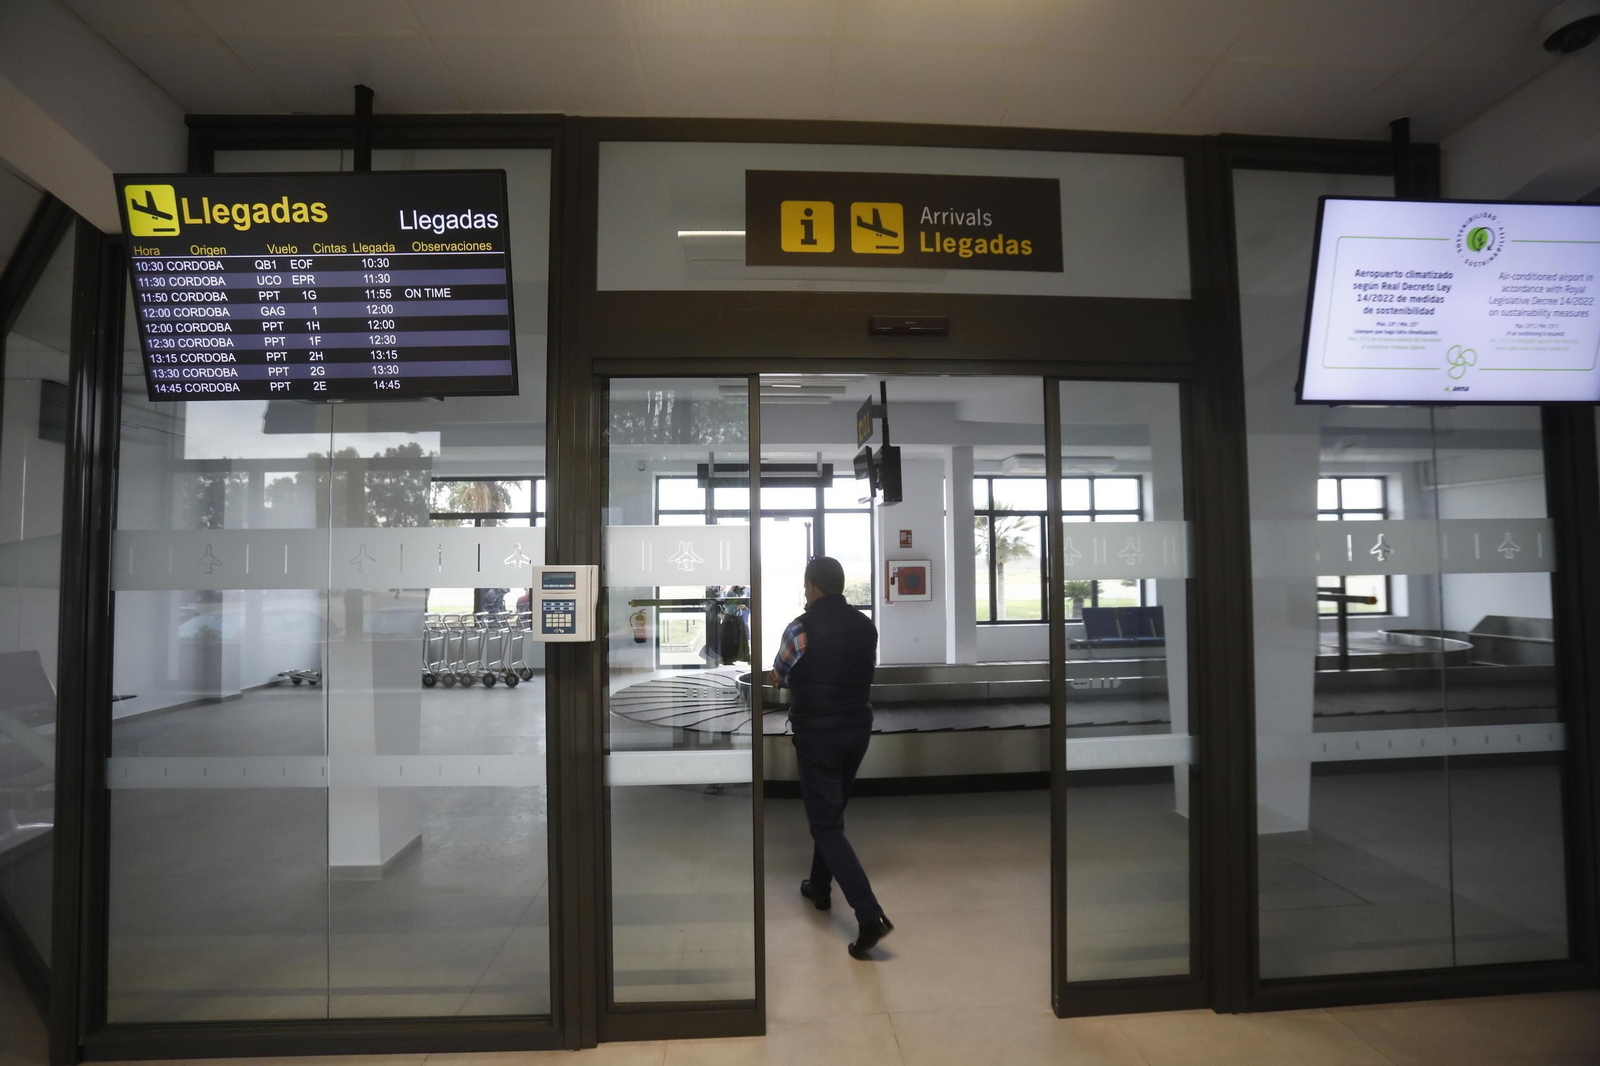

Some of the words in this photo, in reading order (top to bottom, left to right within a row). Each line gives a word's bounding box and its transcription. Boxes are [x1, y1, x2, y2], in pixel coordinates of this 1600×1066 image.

[181, 196, 328, 231] Llegadas
[920, 206, 992, 227] Arrivals
[400, 209, 499, 234] Llegadas
[134, 246, 160, 256] Hora
[190, 245, 227, 257] Origen
[267, 243, 298, 254] Vuelo
[313, 243, 347, 253] Cintas
[353, 242, 396, 254] Llegada
[412, 241, 492, 252] Observaciones
[920, 231, 1033, 258] Llegadas
[136, 262, 163, 271] 10:30
[167, 261, 224, 270] CORDOBA
[255, 260, 276, 270] QB1
[291, 260, 313, 269] EOF
[362, 259, 389, 268] 10:30
[138, 278, 165, 287] 11:30
[169, 276, 226, 286] CORDOBA
[257, 275, 281, 285] UCO
[292, 275, 315, 284] EPR
[364, 274, 390, 283] 11:30
[1354, 269, 1403, 280] Aeropuerto
[1405, 270, 1453, 279] climatizado
[1558, 274, 1584, 282] airport
[1353, 282, 1378, 291] según
[1382, 282, 1400, 290] Real
[1402, 283, 1434, 291] Decreto
[1437, 283, 1452, 293] Ley
[1564, 285, 1586, 295] Royal
[141, 293, 167, 302] 11:50
[172, 292, 228, 301] CORDOBA
[259, 291, 280, 300] PPT
[302, 290, 316, 300] 1G
[365, 289, 391, 299] 11:55
[404, 288, 422, 298] ON
[424, 288, 451, 298] TIME
[1357, 294, 1394, 303] 14/2022
[1396, 295, 1407, 303] de
[1410, 295, 1444, 303] medidas
[1532, 297, 1558, 305] Decree
[1560, 297, 1594, 305] 14/2022
[143, 308, 170, 317] 12:00
[174, 307, 230, 317] CORDOBA
[261, 306, 285, 316] GAG
[313, 306, 318, 315] 1
[366, 305, 393, 314] 12:00
[1363, 306, 1374, 314] de
[1376, 306, 1435, 315] sostenibilidad
[1500, 309, 1552, 318] sustainability
[146, 323, 172, 332] 12:00
[176, 322, 232, 332] CORDOBA
[263, 322, 284, 331] PPT
[306, 321, 320, 330] 1H
[368, 320, 394, 329] 12:00
[148, 338, 175, 348] 12:30
[178, 337, 234, 347] CORDOBA
[265, 337, 285, 346] PPT
[309, 336, 321, 346] 1F
[369, 335, 396, 344] 12:30
[150, 354, 177, 363] 13:15
[181, 352, 236, 362] CORDOBA
[267, 352, 287, 361] PPT
[309, 352, 323, 360] 2H
[371, 350, 397, 359] 13:15
[153, 369, 179, 378] 13:30
[183, 368, 238, 377] CORDOBA
[268, 367, 289, 376] PPT
[311, 367, 325, 376] 2G
[372, 365, 399, 374] 13:30
[155, 384, 181, 393] 14:45
[185, 383, 240, 392] CORDOBA
[271, 382, 291, 391] PPT
[314, 382, 326, 390] 2E
[374, 380, 400, 389] 14:45
